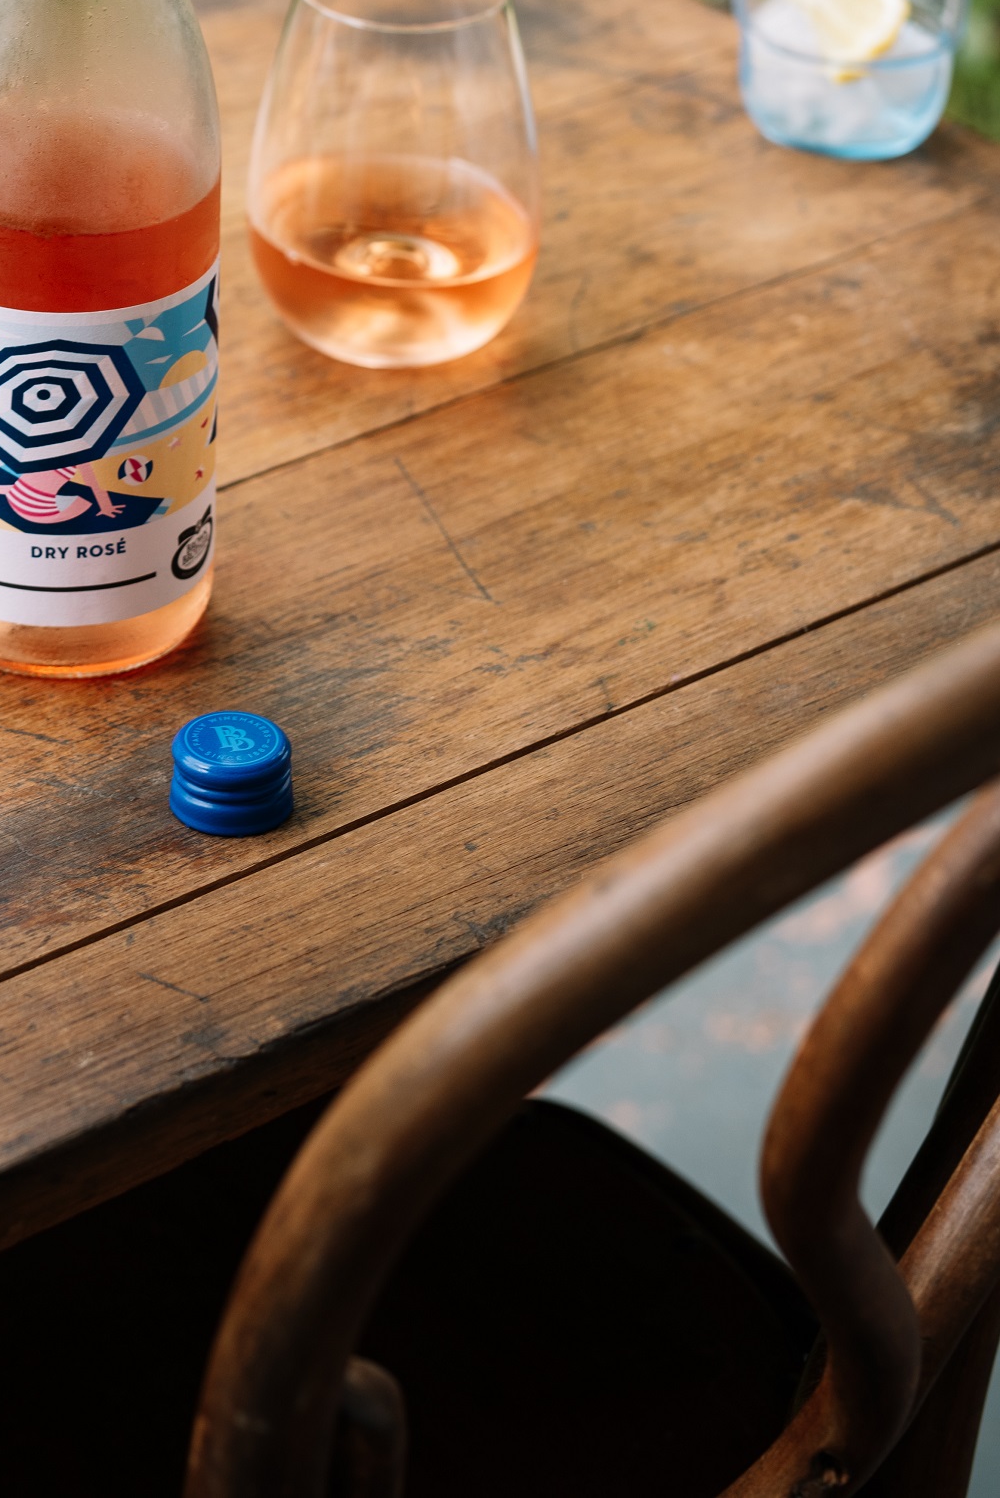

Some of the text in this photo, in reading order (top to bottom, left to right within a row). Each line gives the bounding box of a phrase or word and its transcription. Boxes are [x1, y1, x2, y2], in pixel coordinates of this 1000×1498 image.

[31, 537, 127, 560] DRY ROSÉ
[191, 715, 272, 747] FAMILY WINEMAKERS
[204, 750, 243, 761] SINCE
